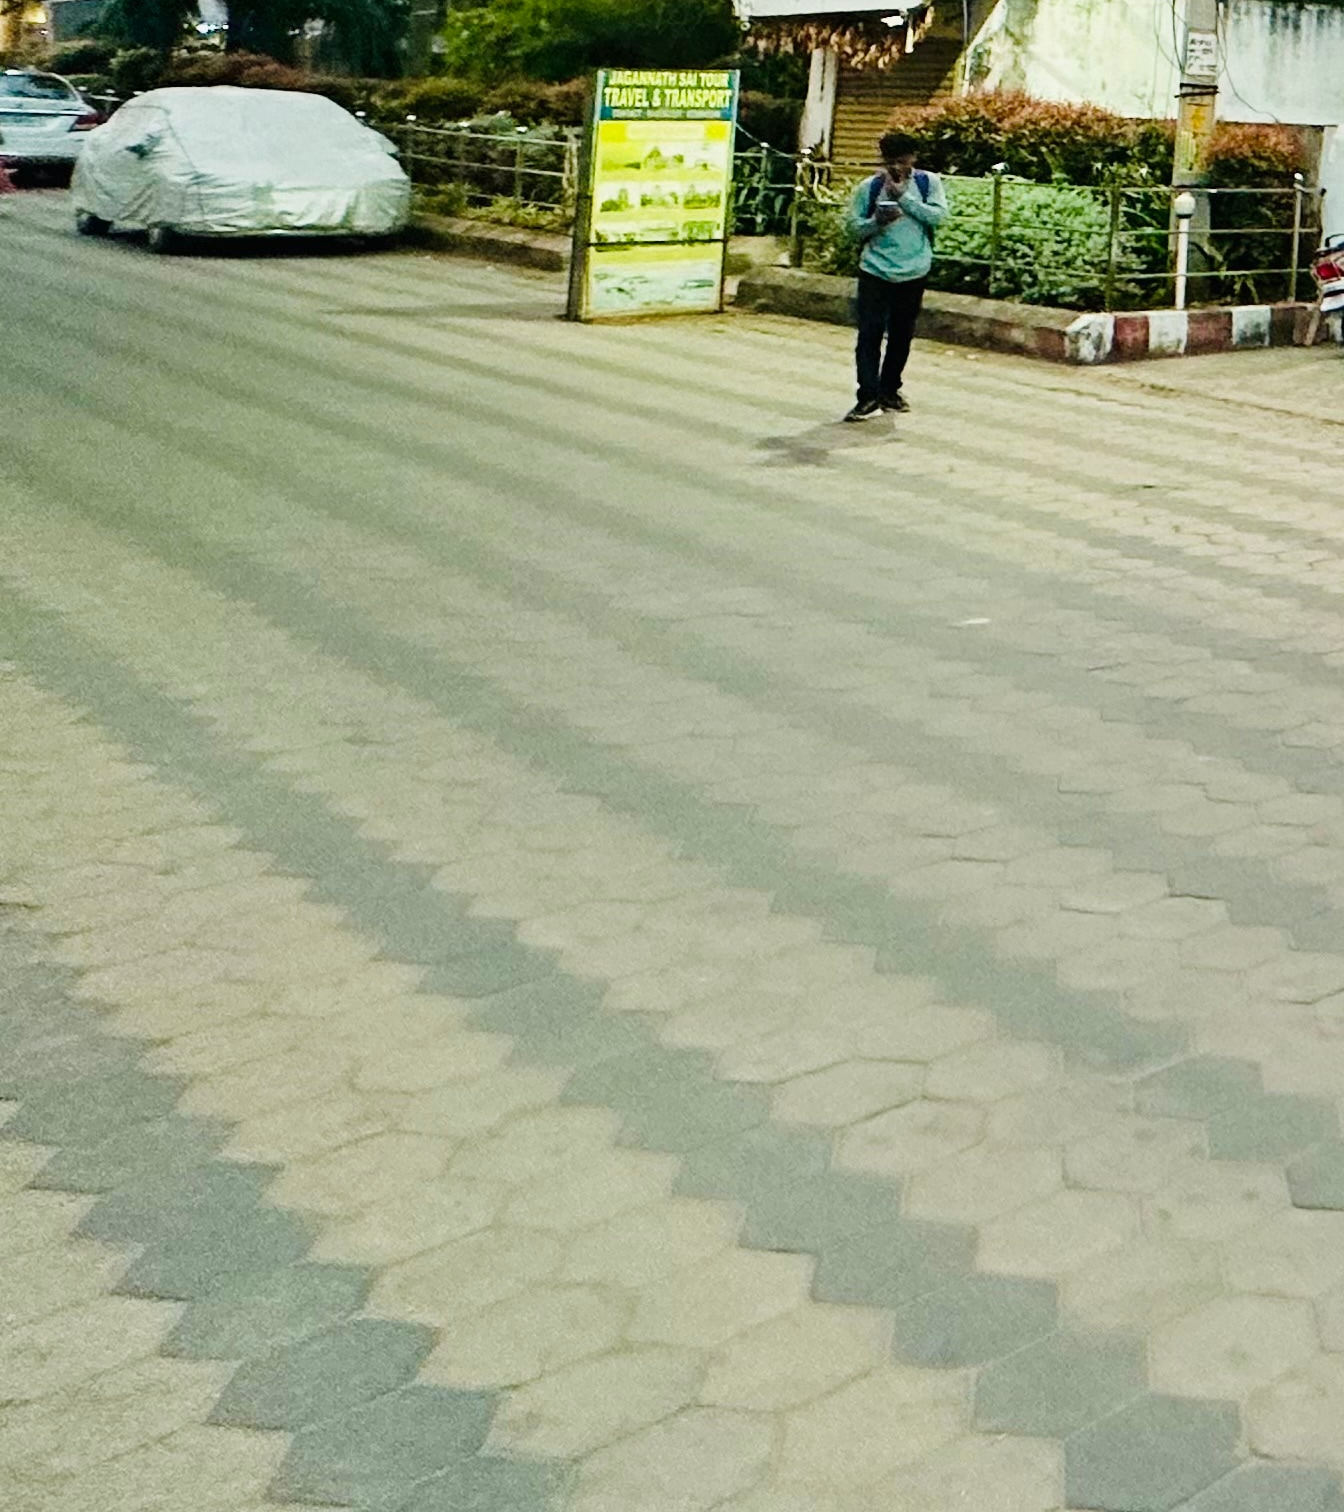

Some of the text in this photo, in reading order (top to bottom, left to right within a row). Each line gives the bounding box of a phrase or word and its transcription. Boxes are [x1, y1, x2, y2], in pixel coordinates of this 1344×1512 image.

[609, 70, 729, 88] JAGANNATH SAI TOUR
[604, 87, 732, 108] TRAVEL & TRANSPORT
